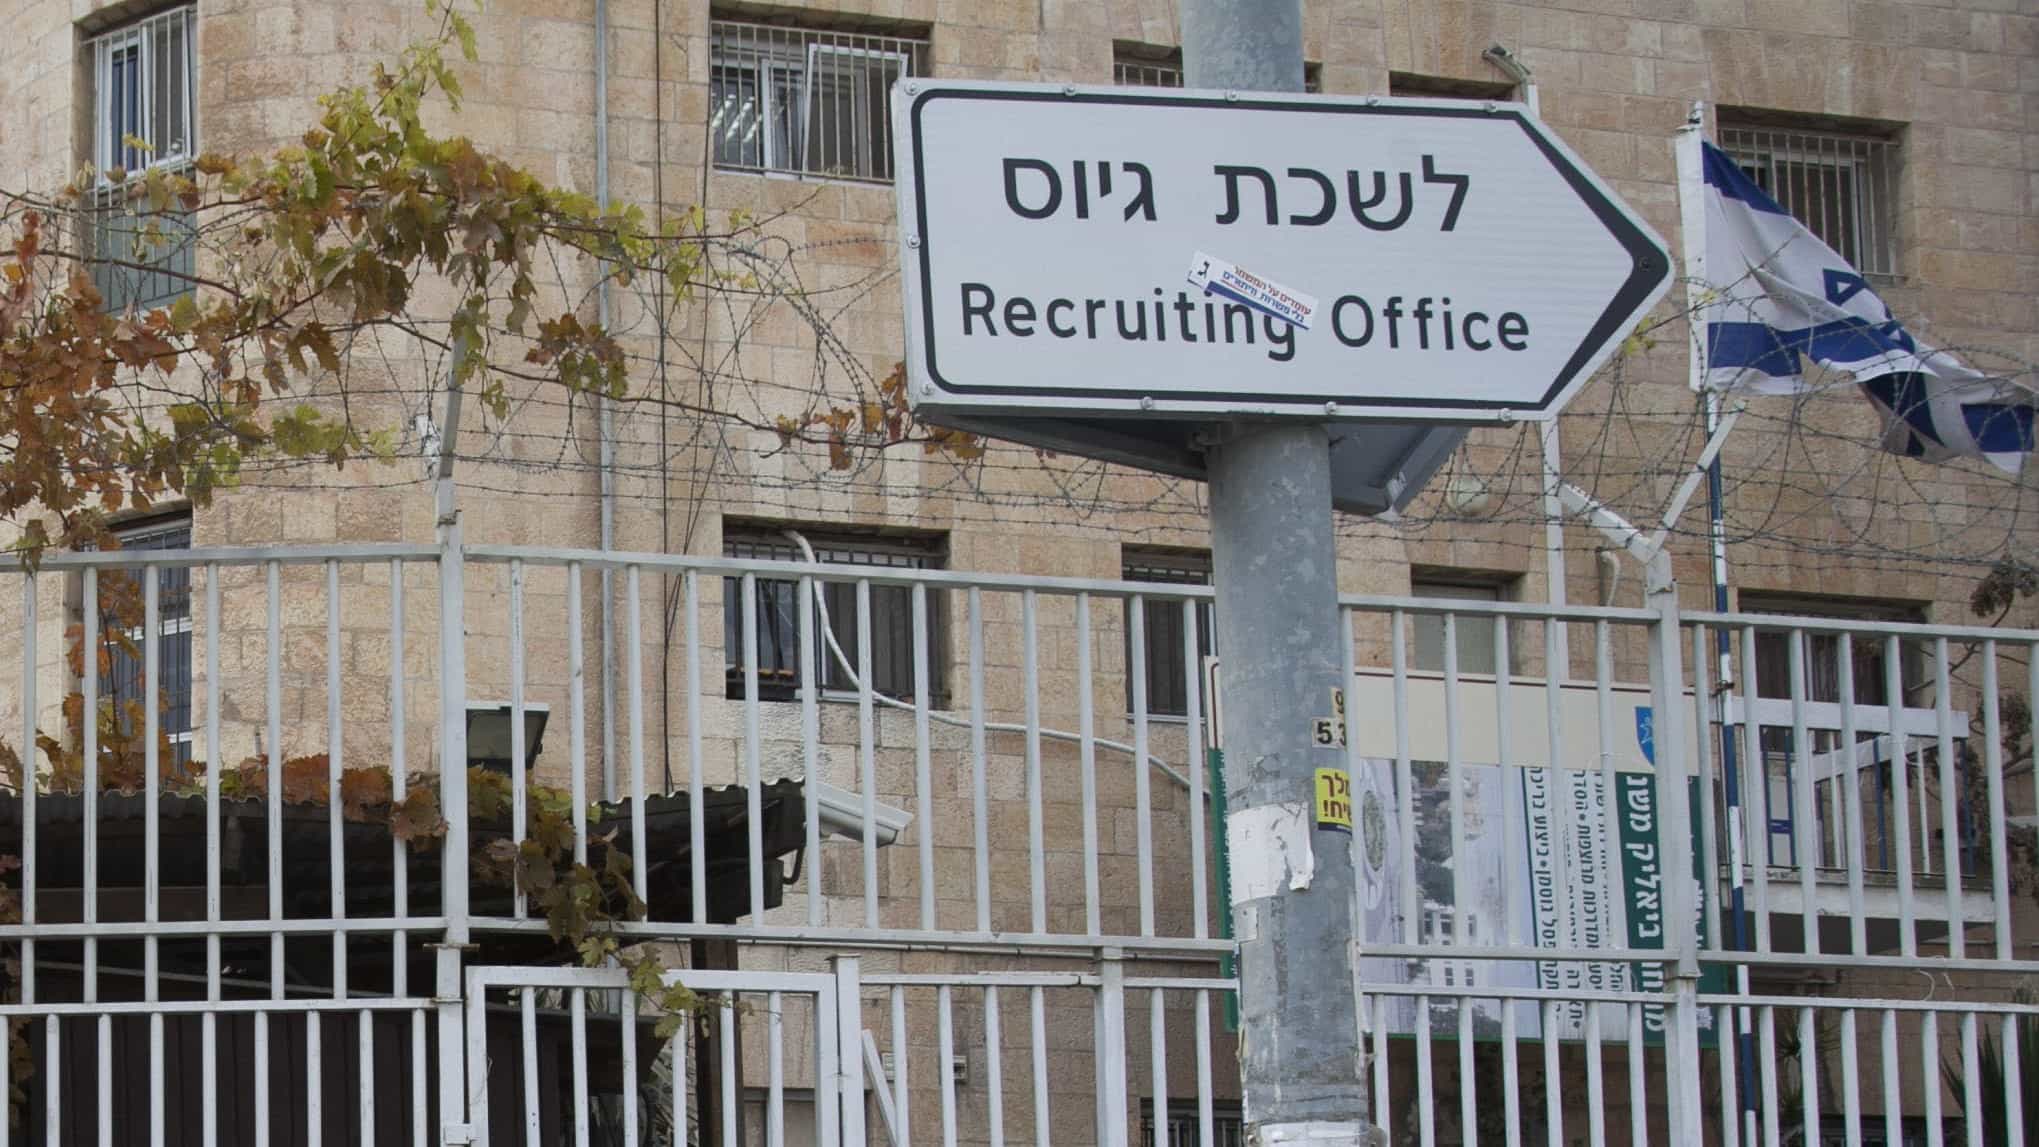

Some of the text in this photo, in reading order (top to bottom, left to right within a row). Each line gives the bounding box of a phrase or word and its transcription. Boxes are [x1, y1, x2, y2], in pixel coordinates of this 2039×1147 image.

[1002, 154, 1470, 232] לשכת גיוס
[960, 282, 1530, 362] Recruiting Office
[1322, 772, 1351, 798] לך
[1572, 769, 1589, 810] הסדר
[1626, 775, 1653, 833] משנ
[1625, 843, 1663, 938] ביאליק
